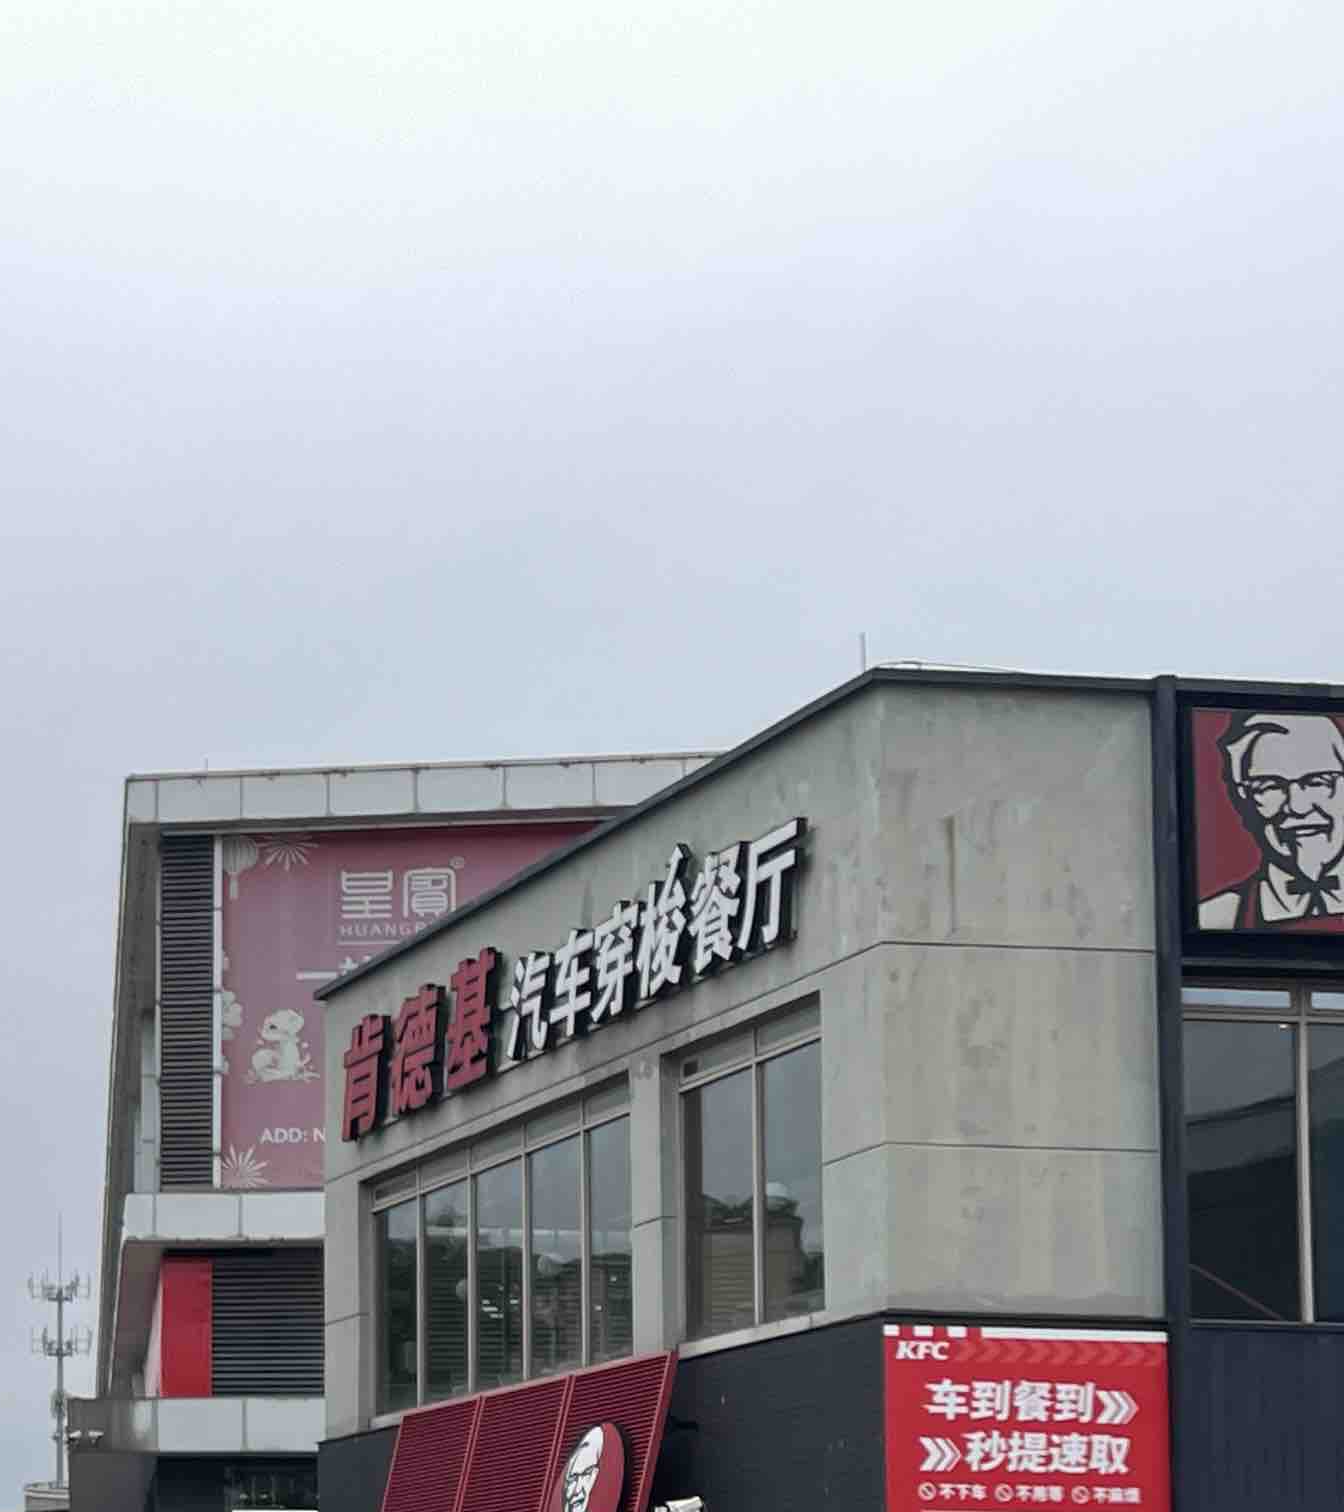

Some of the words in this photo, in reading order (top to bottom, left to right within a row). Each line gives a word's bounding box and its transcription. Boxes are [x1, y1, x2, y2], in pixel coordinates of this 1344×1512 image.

[341, 817, 808, 1142] 肯德基汽车穿梭餐厅
[259, 1127, 306, 1143] ADD:
[895, 1340, 950, 1361] KFC
[923, 1378, 1096, 1425] 车到餐到
[963, 1429, 1132, 1476] 秒提速取
[939, 1483, 988, 1500] 不下车
